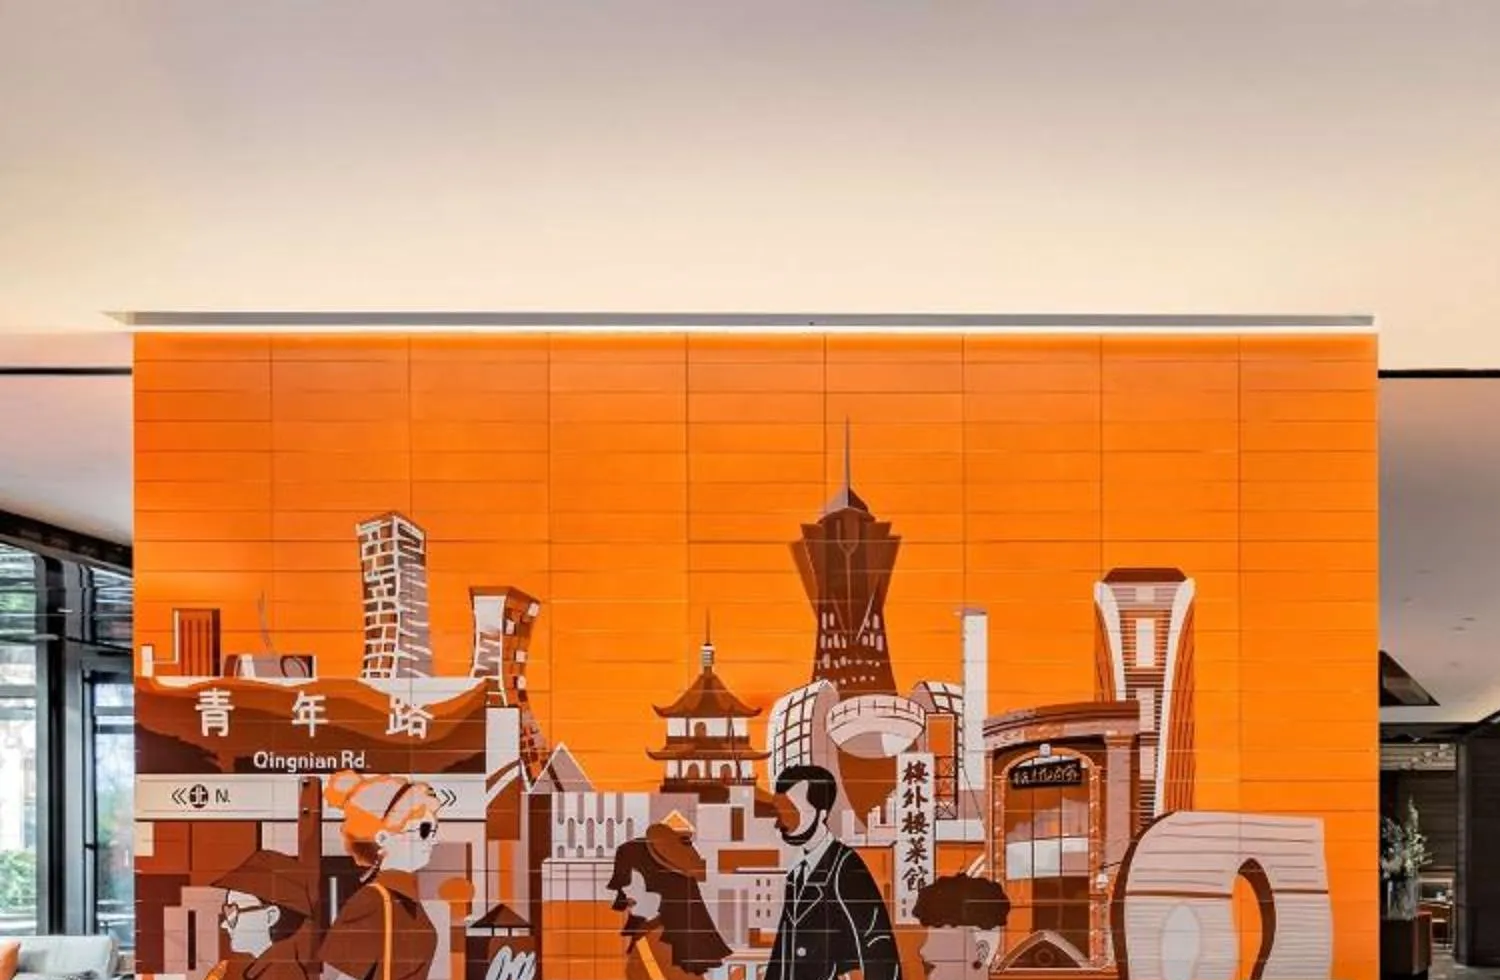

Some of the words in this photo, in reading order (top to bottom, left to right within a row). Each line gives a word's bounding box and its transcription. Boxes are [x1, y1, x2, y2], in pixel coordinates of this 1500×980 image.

[195, 687, 434, 739] 青年路
[253, 751, 338, 773] Qingnian
[341, 751, 371, 769] Rd.
